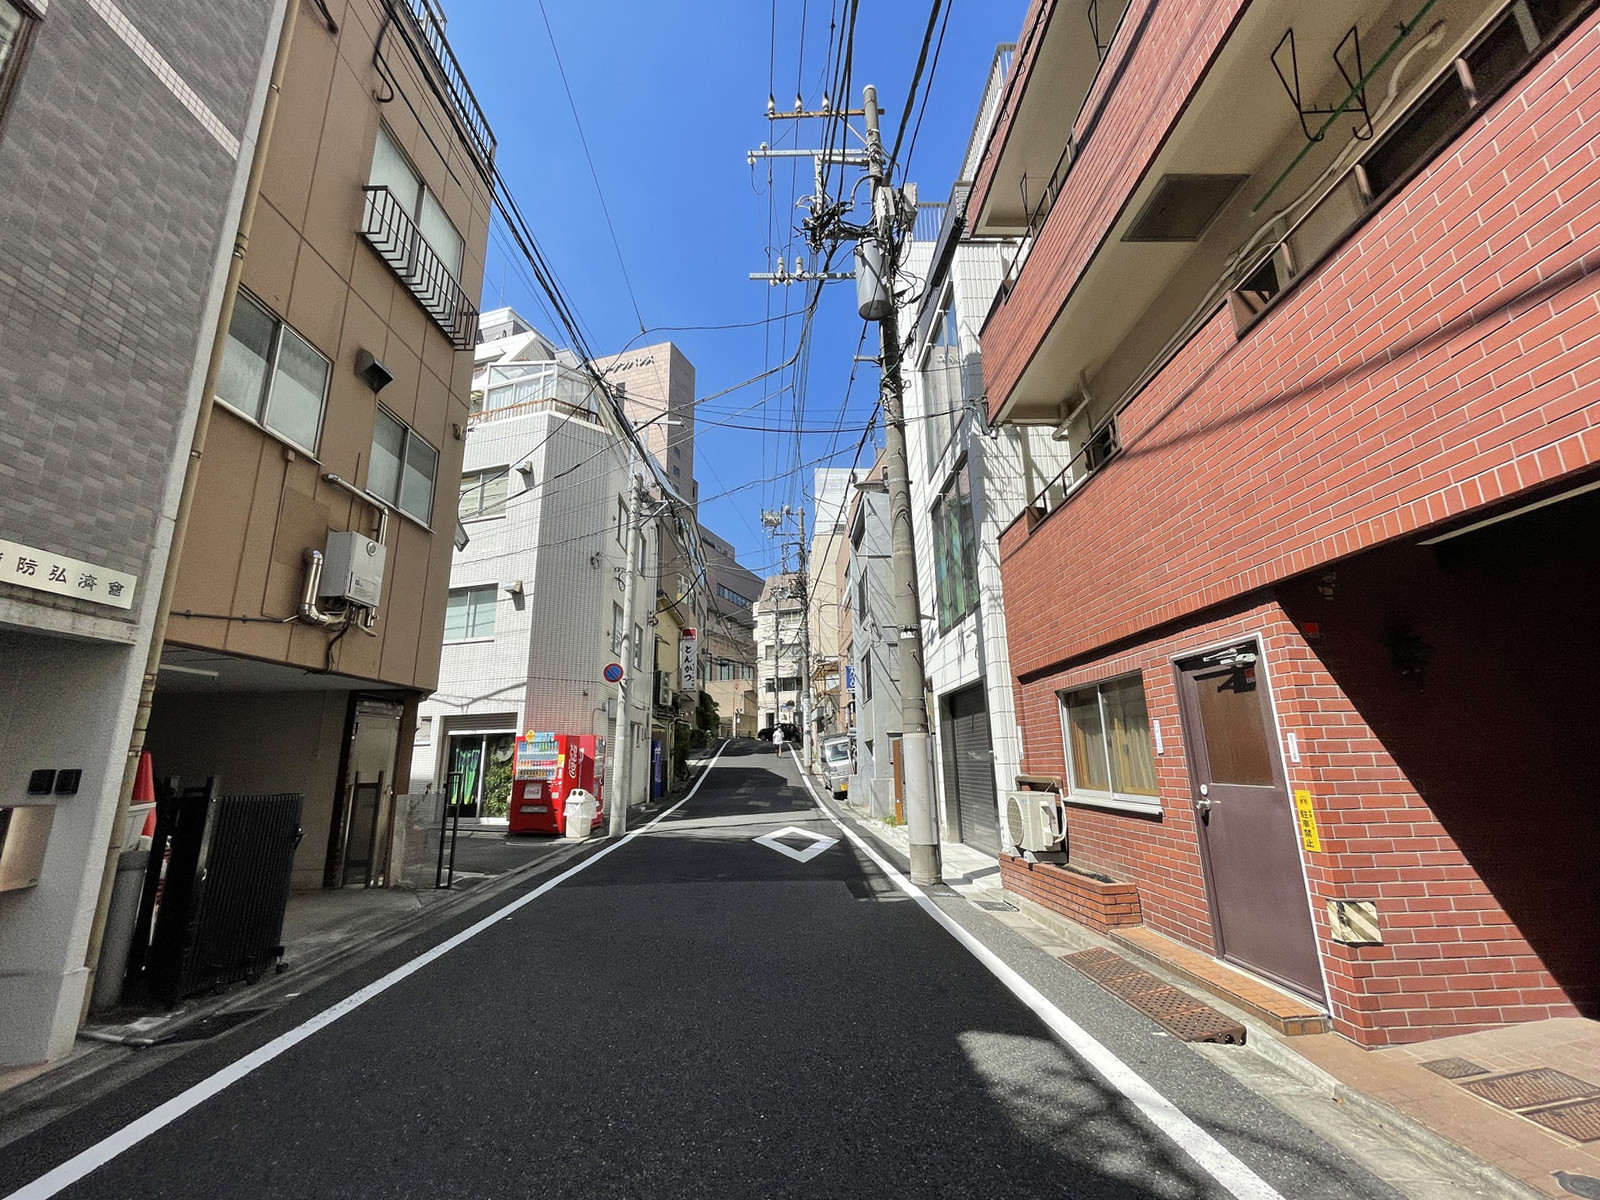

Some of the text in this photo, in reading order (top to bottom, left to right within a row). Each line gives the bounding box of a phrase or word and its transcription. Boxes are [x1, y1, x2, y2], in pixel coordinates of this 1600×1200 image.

[684, 645, 692, 682] とんかつ
[1300, 809, 1314, 848] 駐車禁止
